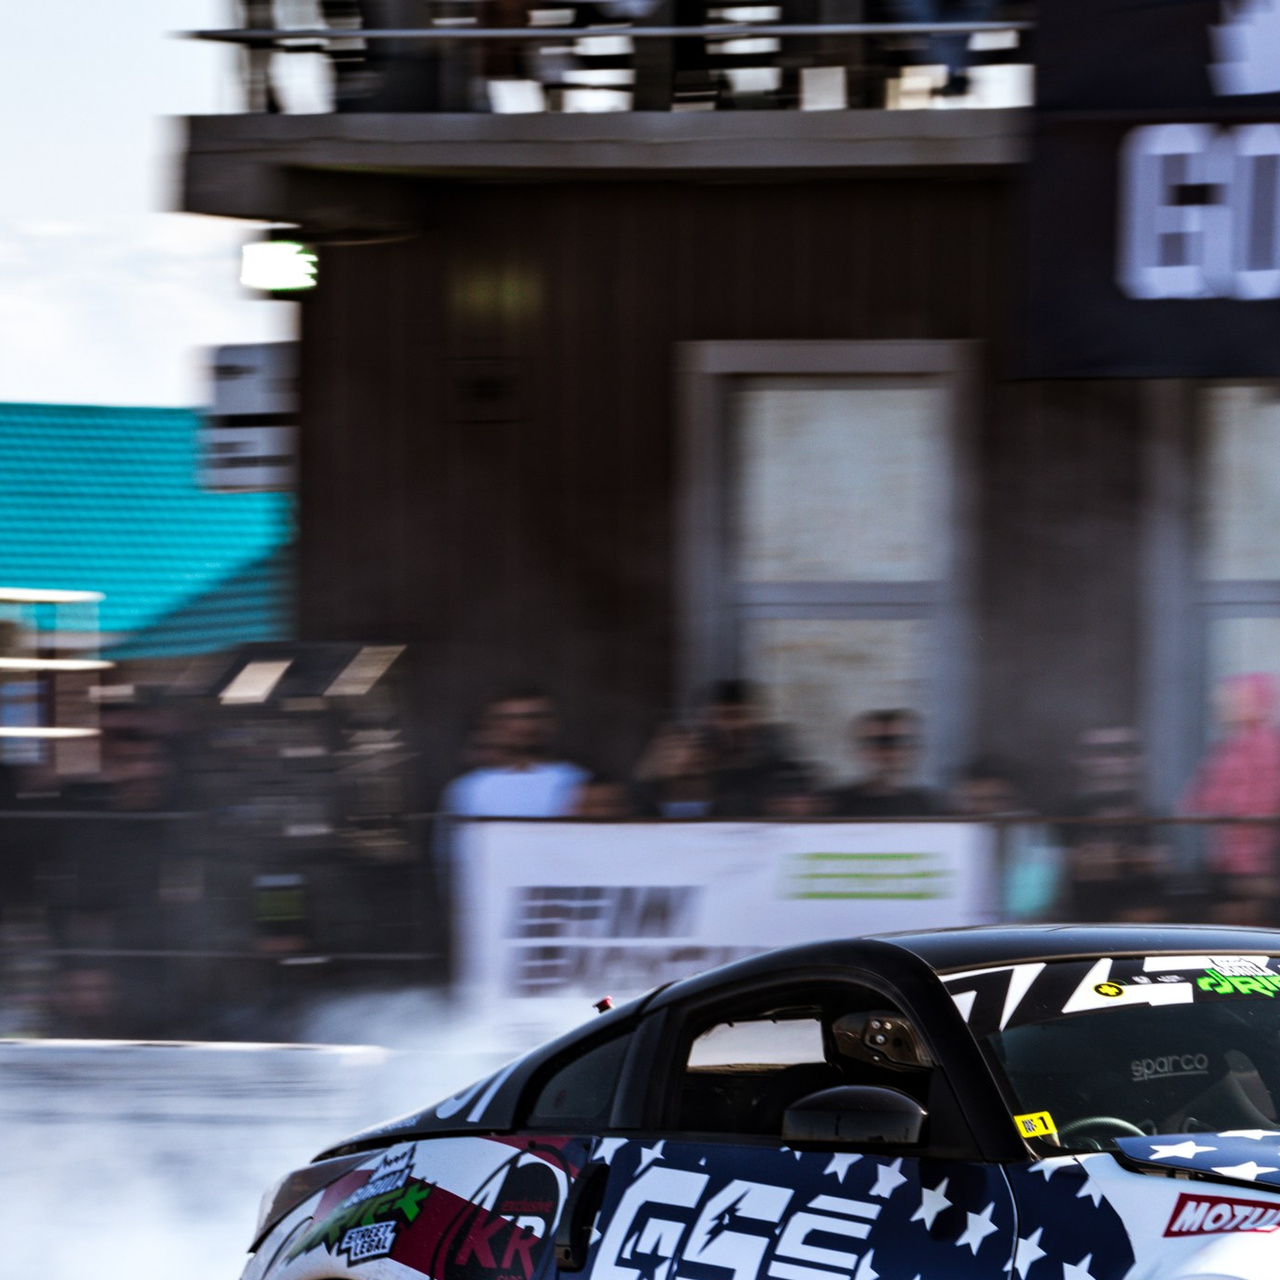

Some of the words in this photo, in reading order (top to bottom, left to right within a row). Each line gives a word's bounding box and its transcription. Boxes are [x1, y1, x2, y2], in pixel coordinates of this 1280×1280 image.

[1131, 1053, 1209, 1079] sparco
[345, 1222, 395, 1245] STREET
[455, 1212, 547, 1275] KR
